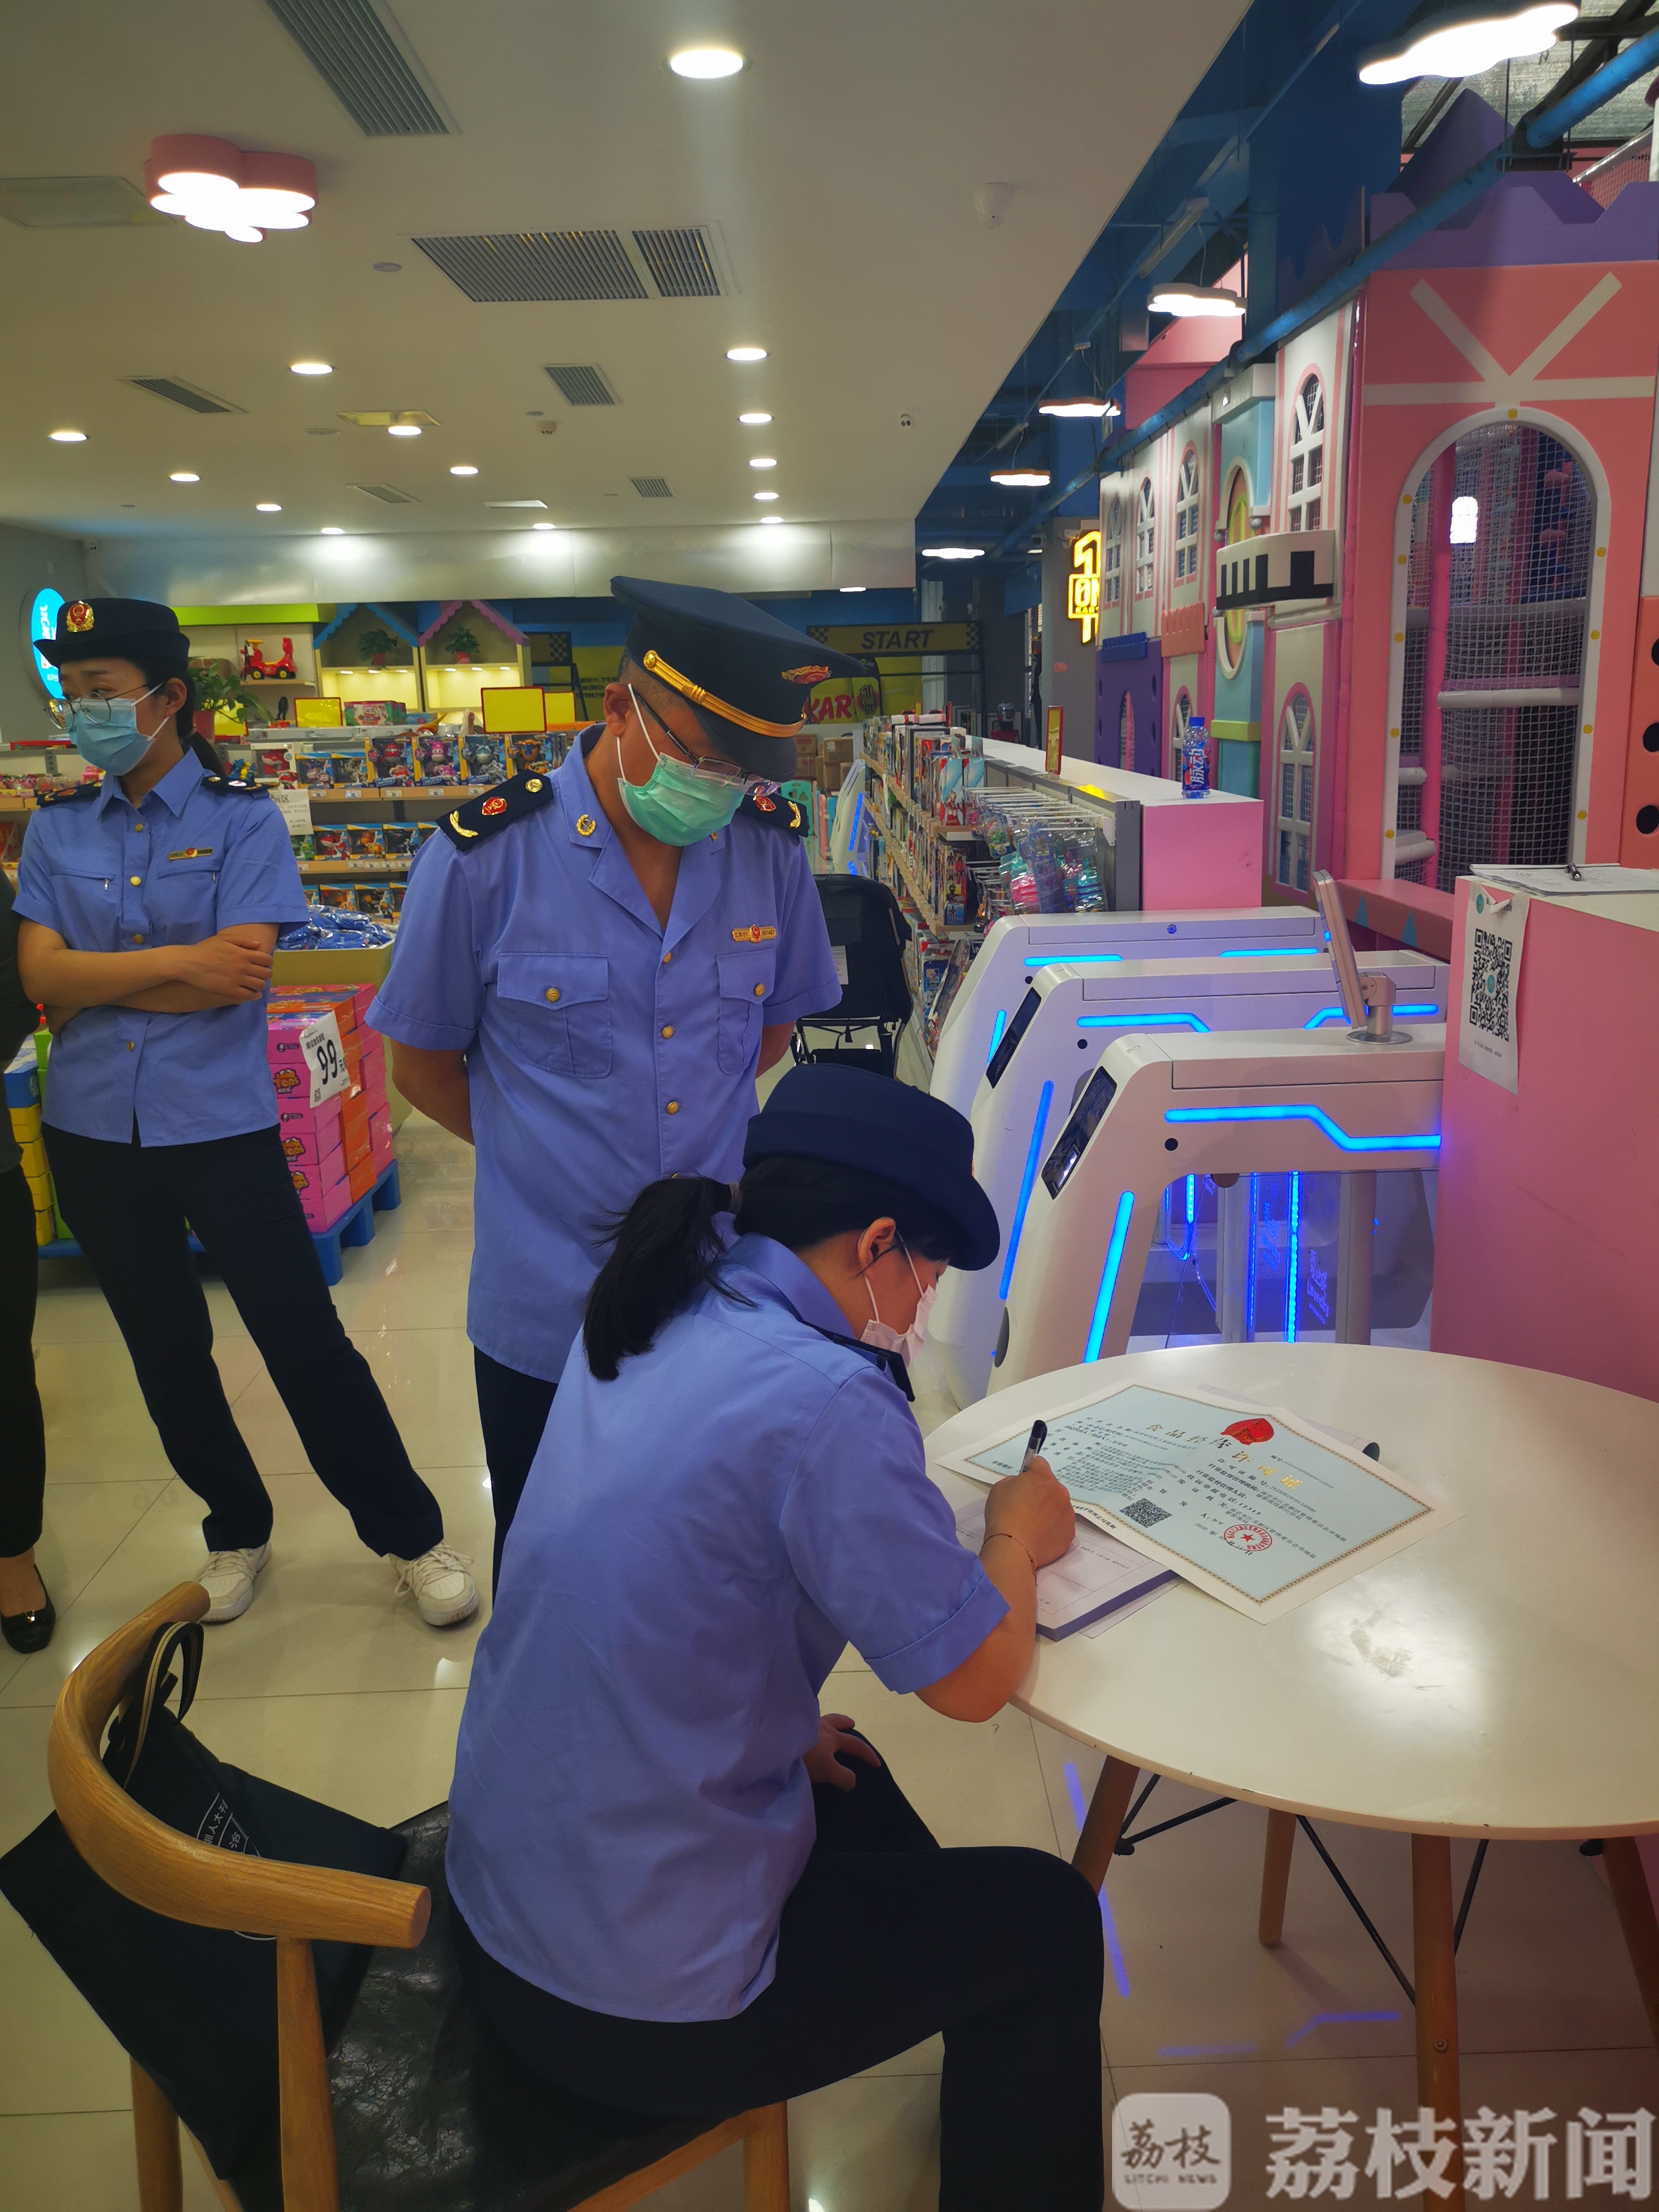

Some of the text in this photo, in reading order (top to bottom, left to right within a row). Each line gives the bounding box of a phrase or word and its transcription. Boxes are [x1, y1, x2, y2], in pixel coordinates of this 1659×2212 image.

[862, 629, 934, 649] START
[803, 694, 854, 724] KAR
[1188, 748, 1207, 784] 脉动
[317, 1039, 338, 1085] 99
